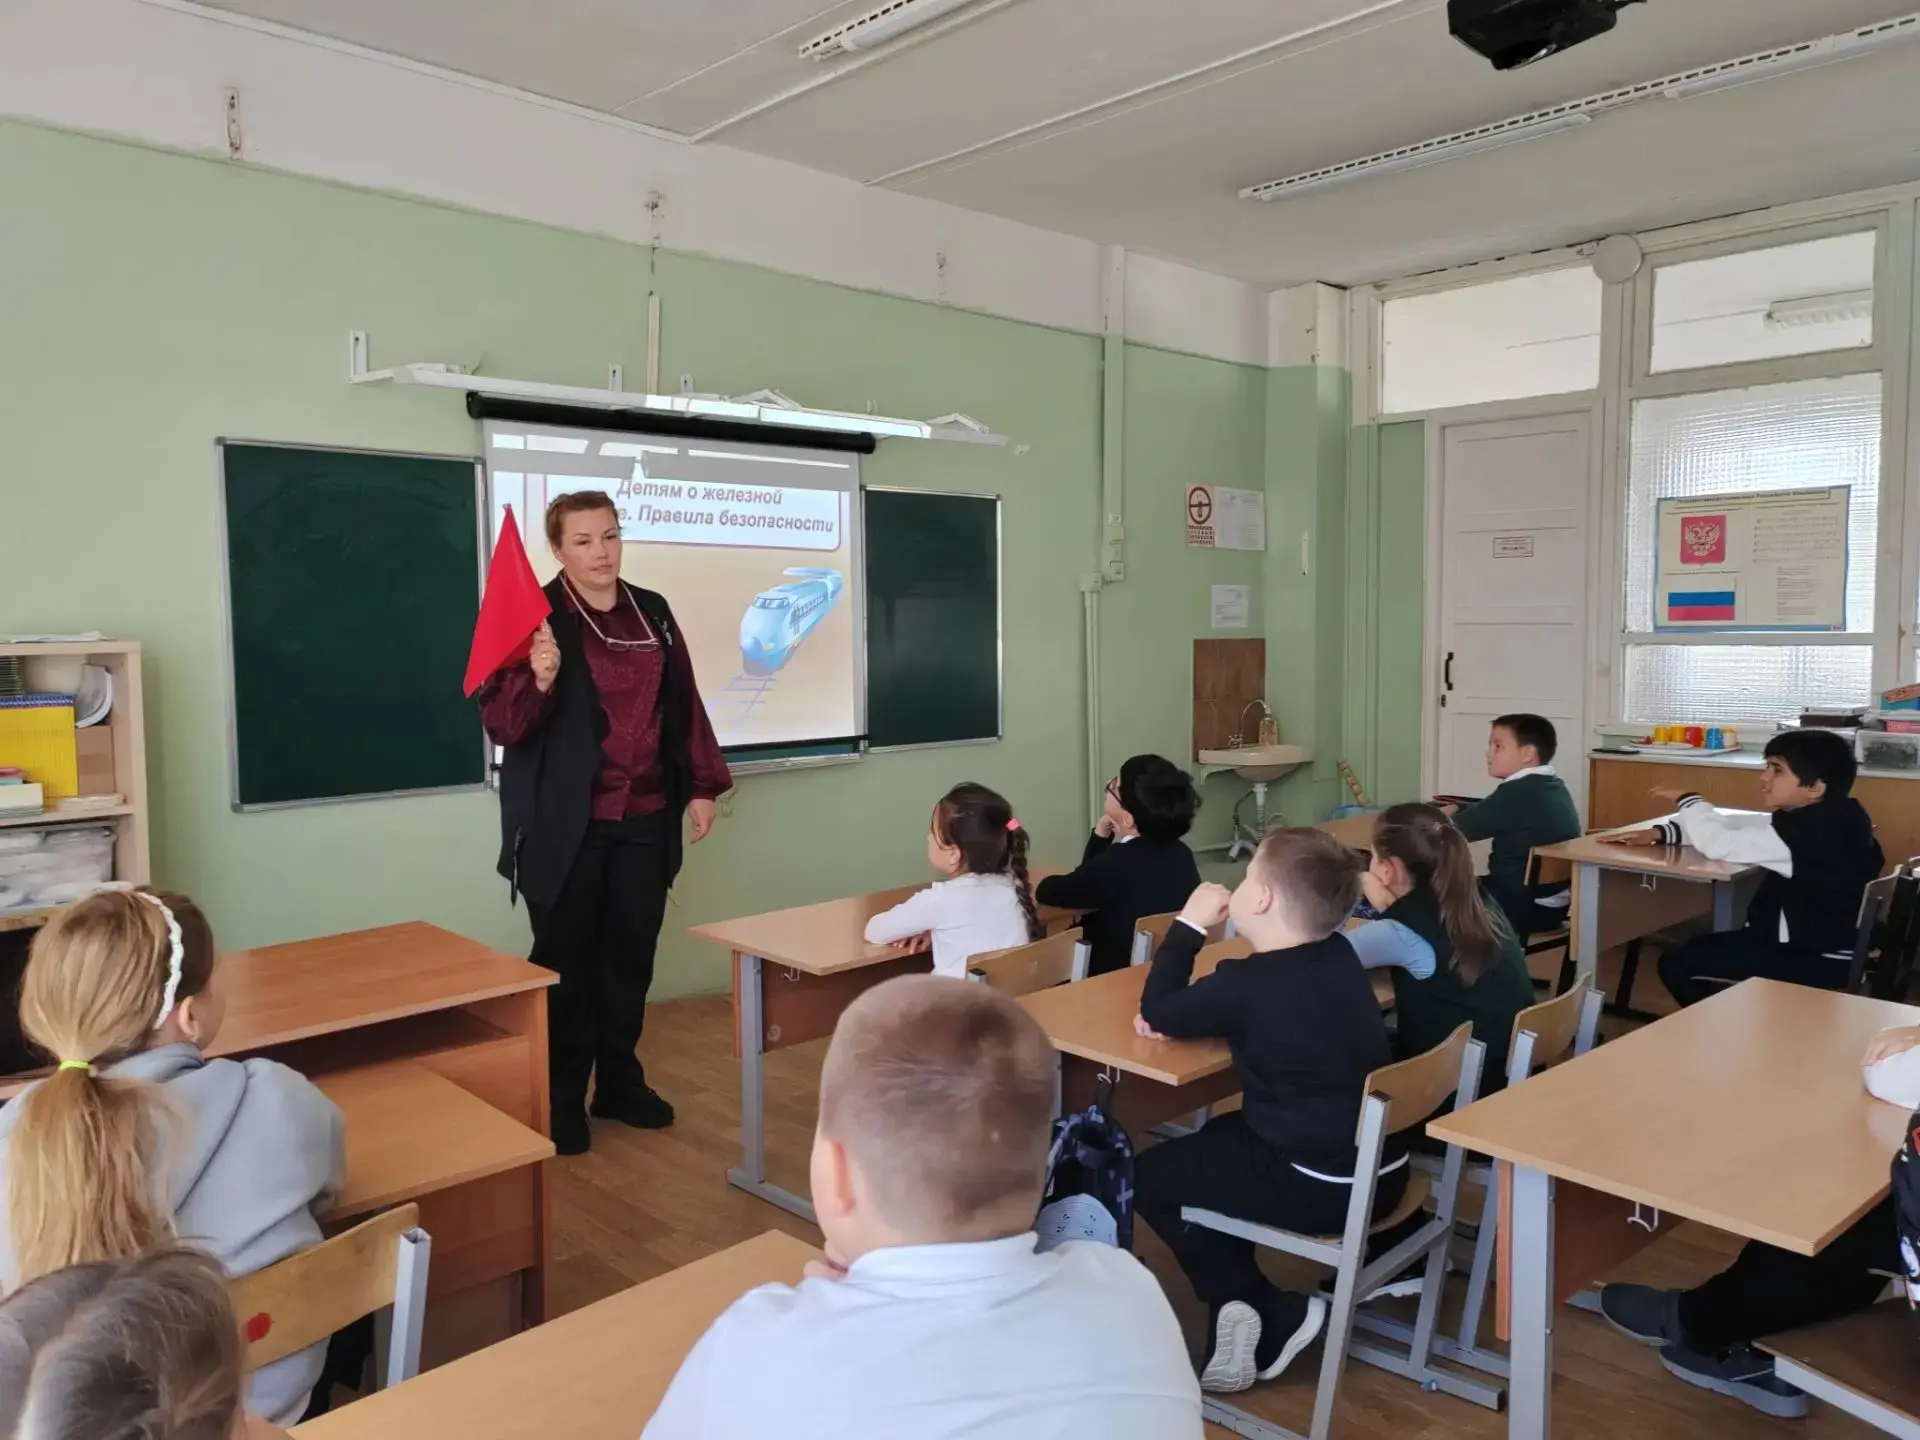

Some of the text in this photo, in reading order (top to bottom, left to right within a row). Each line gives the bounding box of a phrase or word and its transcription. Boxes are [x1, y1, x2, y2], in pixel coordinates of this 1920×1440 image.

[616, 480, 783, 504] Детям о железной
[638, 504, 714, 526] Правила
[719, 509, 834, 532] безопасности
